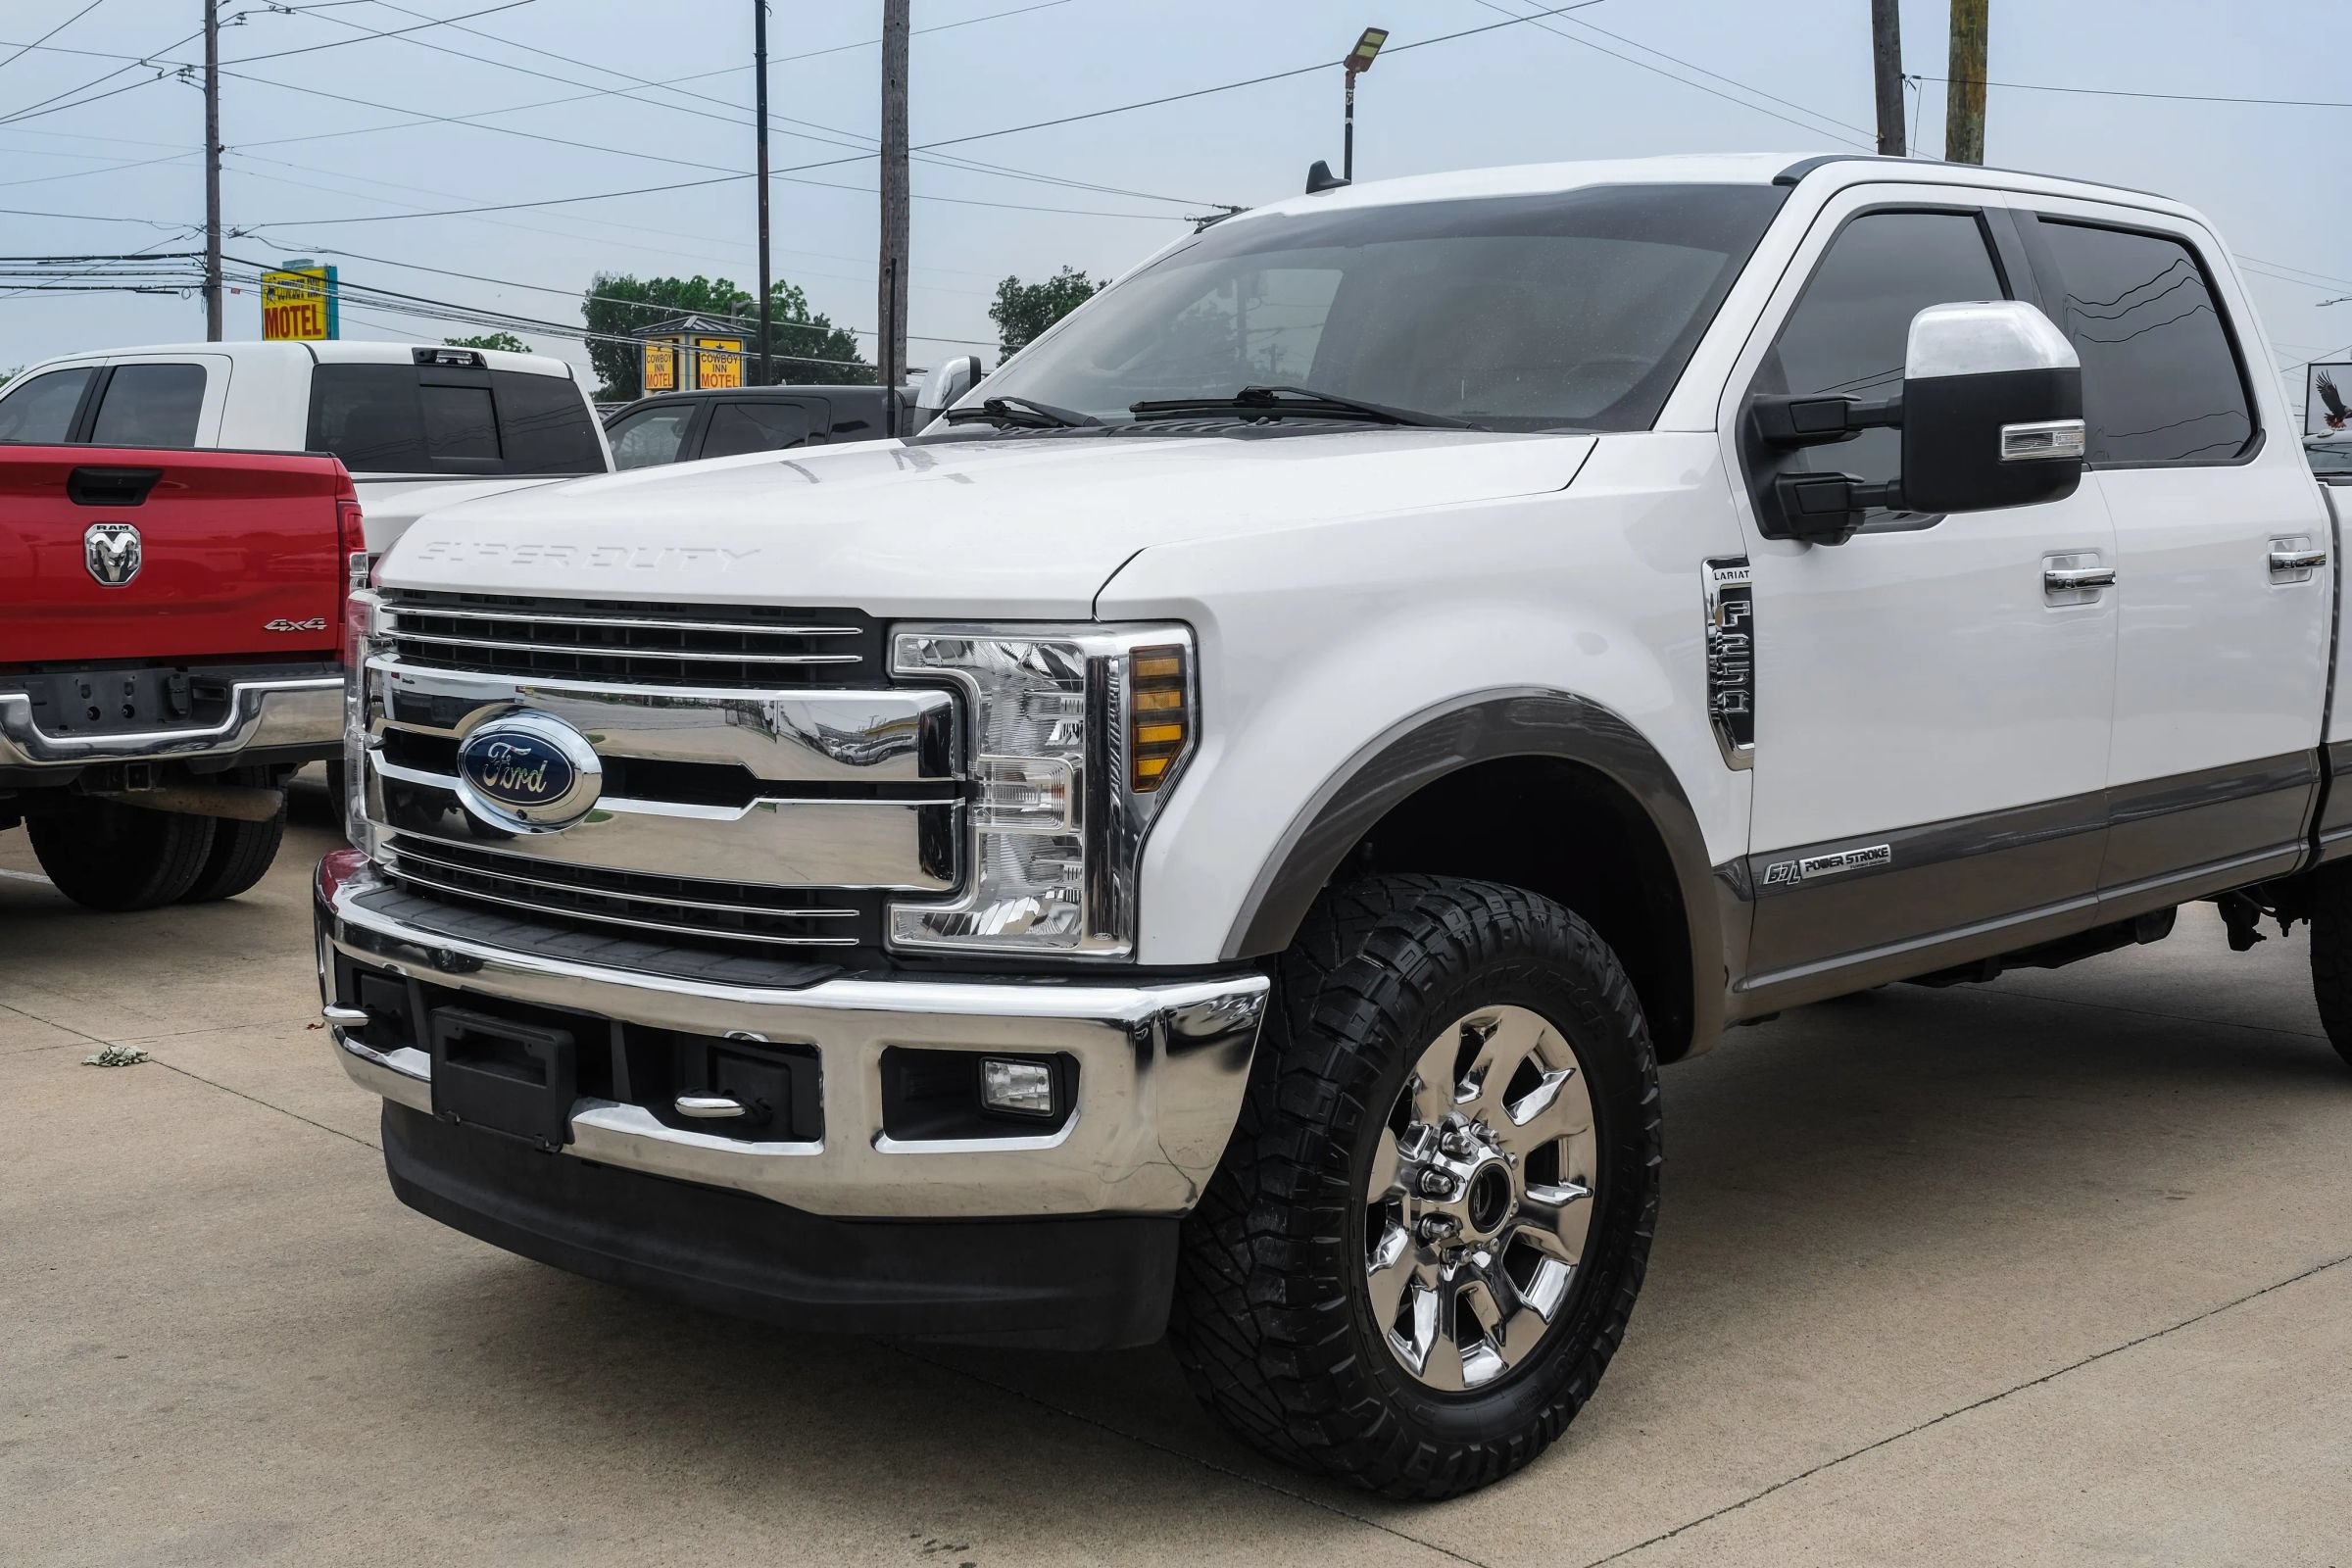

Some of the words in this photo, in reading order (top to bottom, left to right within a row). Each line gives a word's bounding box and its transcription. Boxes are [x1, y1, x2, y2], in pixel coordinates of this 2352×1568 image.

[264, 304, 322, 339] MOTEL
[646, 354, 672, 364] COWBOY
[701, 354, 738, 365] COWBOY
[654, 364, 664, 372] INN
[712, 364, 727, 372] INN
[647, 372, 672, 388] MOTEL
[701, 373, 739, 388] MOTEL
[417, 541, 579, 568] SUPER
[581, 546, 762, 573] DUTY
[1714, 569, 1750, 581] LARIAT
[264, 617, 328, 632] 4x4
[482, 741, 549, 793] Ford
[1804, 855, 1844, 872] POWER
[1845, 846, 1889, 864] STROKE
